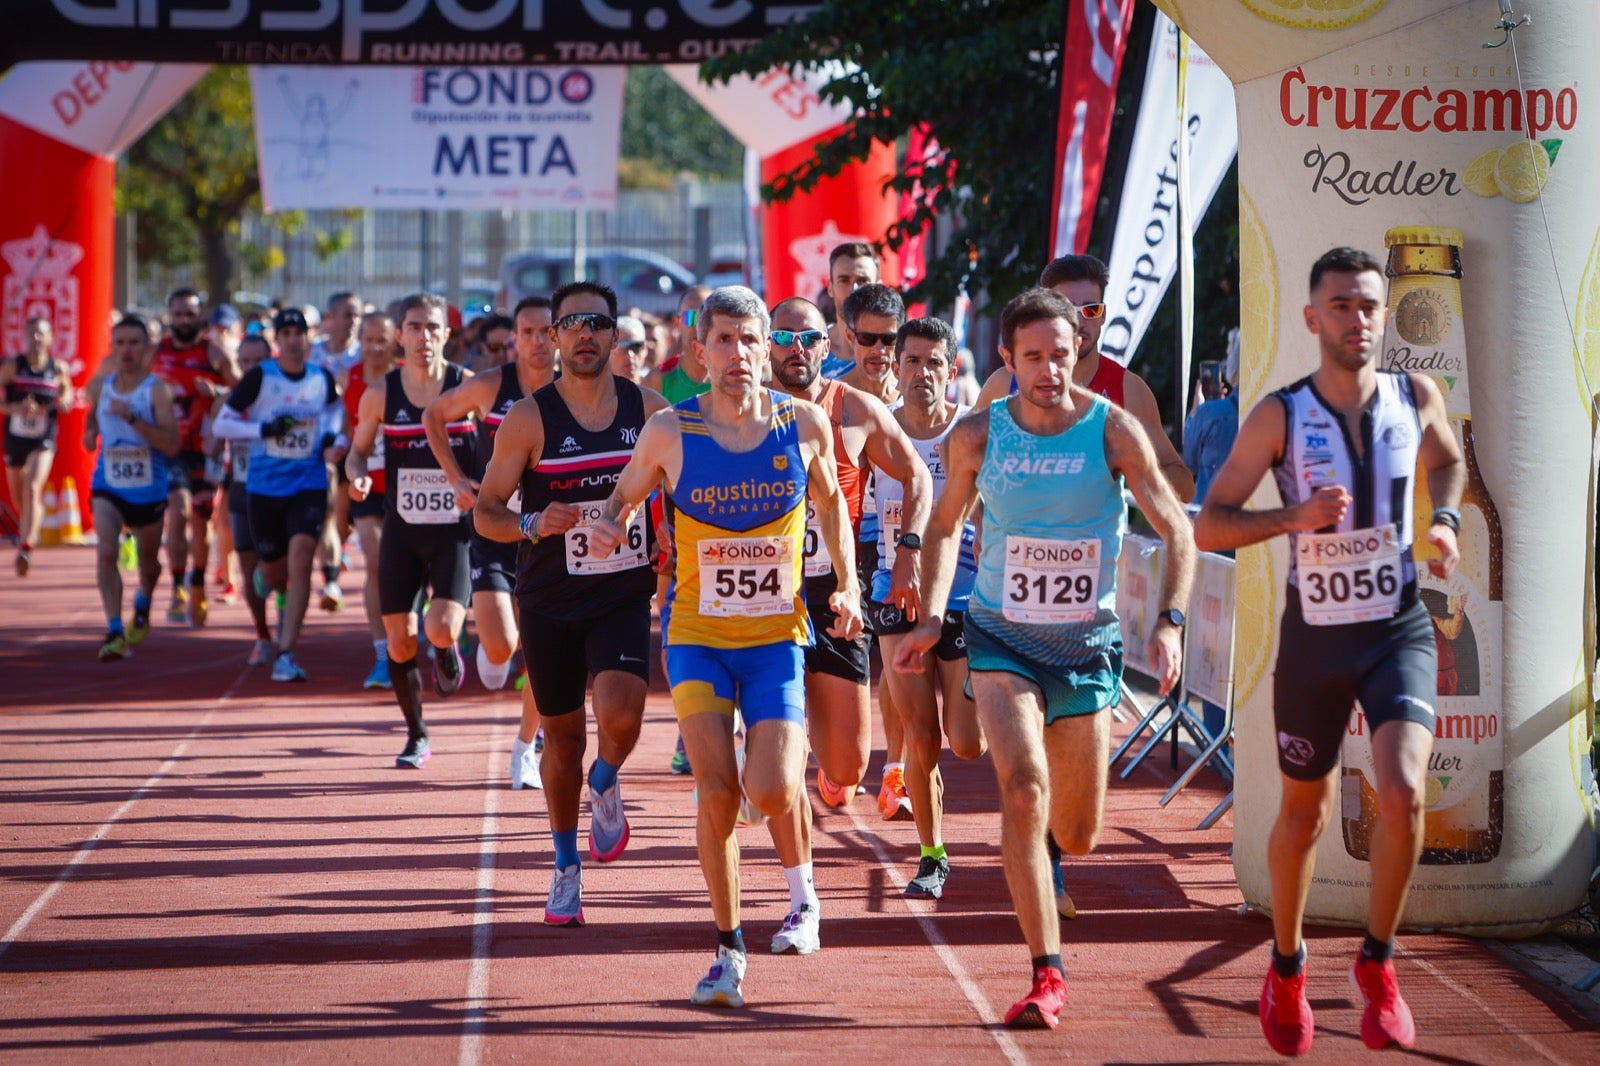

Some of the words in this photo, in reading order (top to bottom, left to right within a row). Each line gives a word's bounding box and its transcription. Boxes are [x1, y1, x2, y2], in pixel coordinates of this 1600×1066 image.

[217, 41, 333, 62] TIENDA
[371, 42, 523, 62] RUNNING
[554, 41, 649, 60] TRAIL
[1354, 64, 1429, 78] DESDE
[1454, 65, 1513, 78] 1904
[421, 69, 594, 106] FONDO
[1280, 66, 1577, 141] Cruzcampo
[433, 134, 577, 176] META
[1304, 144, 1461, 206] Radler
[1386, 346, 1463, 373] Radler
[111, 461, 145, 480] 582
[1001, 458, 1086, 474] RAICES
[402, 492, 455, 511] 3058
[691, 479, 796, 508] agustinos
[708, 502, 780, 515] GRANADA
[719, 545, 776, 559] FONDO
[1025, 547, 1083, 562] FONDO
[1316, 538, 1379, 557] FONDO
[716, 568, 781, 599] 554
[1009, 573, 1093, 604] 3129
[1306, 564, 1397, 604] 3056
[1312, 876, 1336, 885] CAMPO
